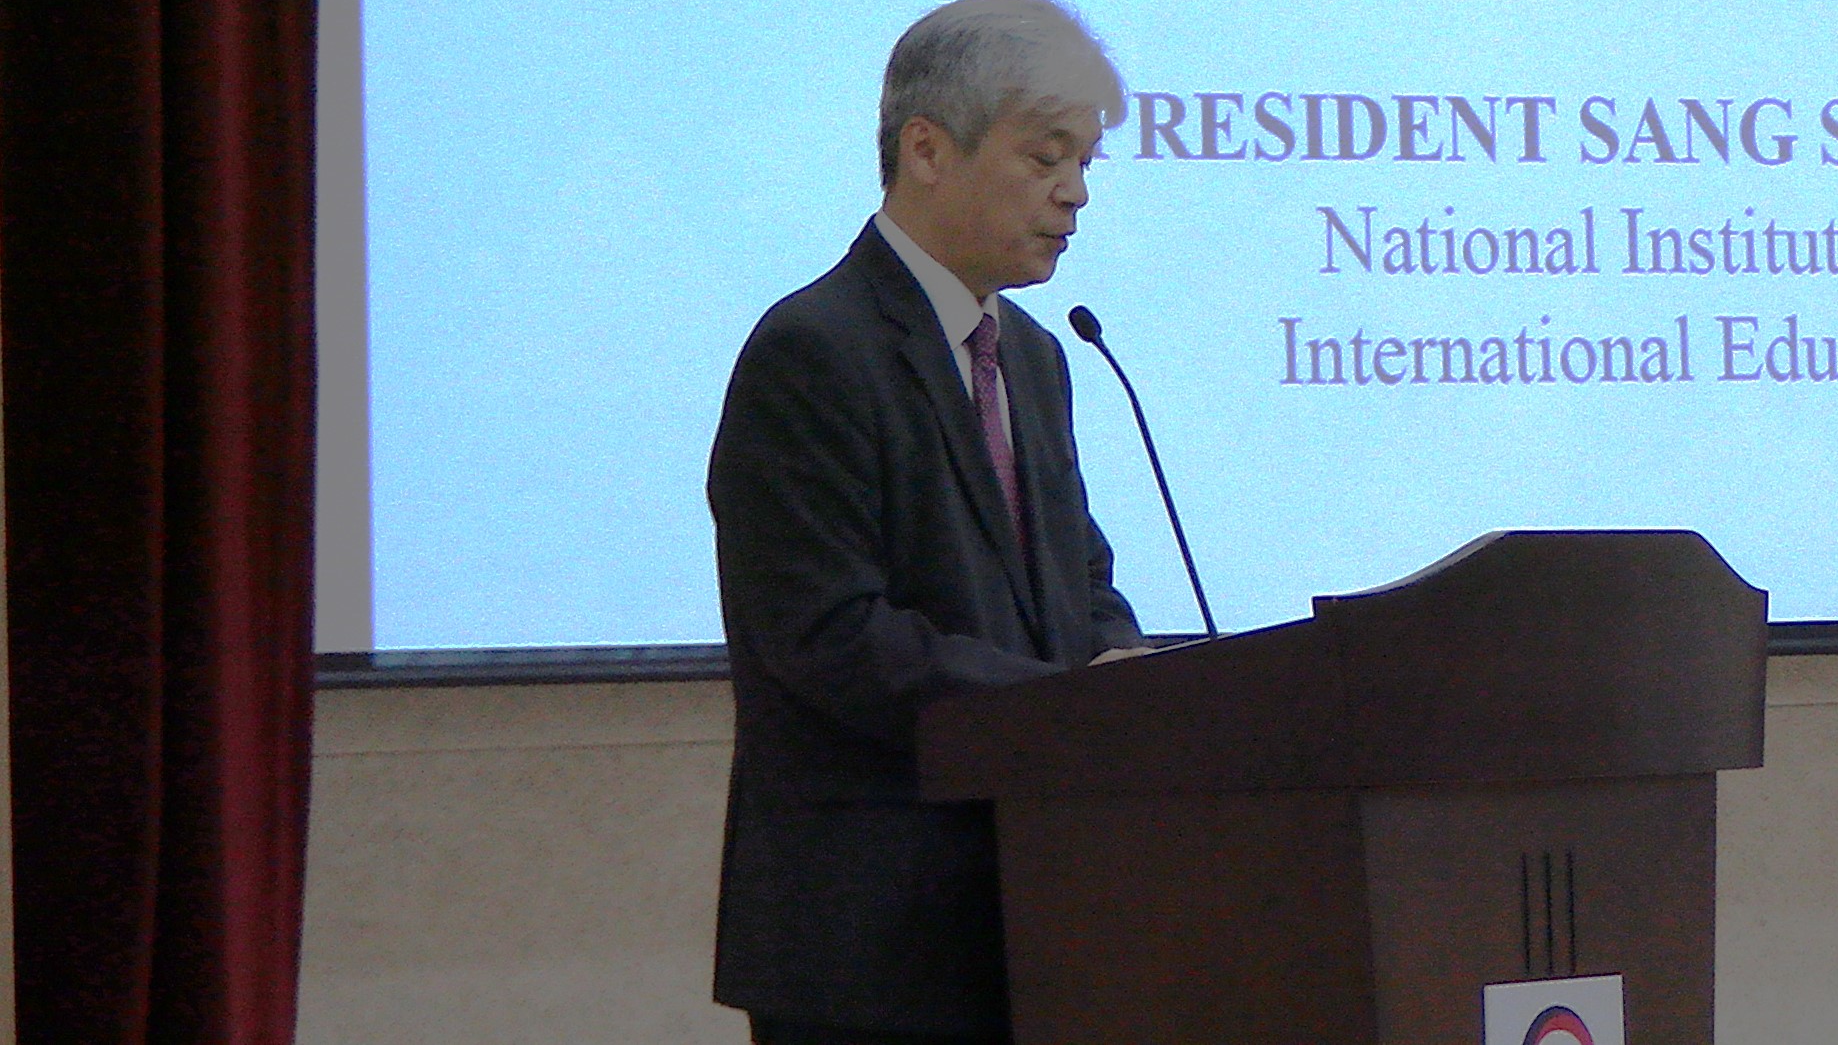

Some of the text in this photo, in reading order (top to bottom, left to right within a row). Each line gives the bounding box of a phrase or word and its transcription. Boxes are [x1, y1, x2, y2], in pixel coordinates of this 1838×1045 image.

[1092, 91, 1557, 163] RESIDENT
[1579, 95, 1799, 166] SANG
[1315, 206, 1601, 275] National
[1278, 315, 1695, 386] International
